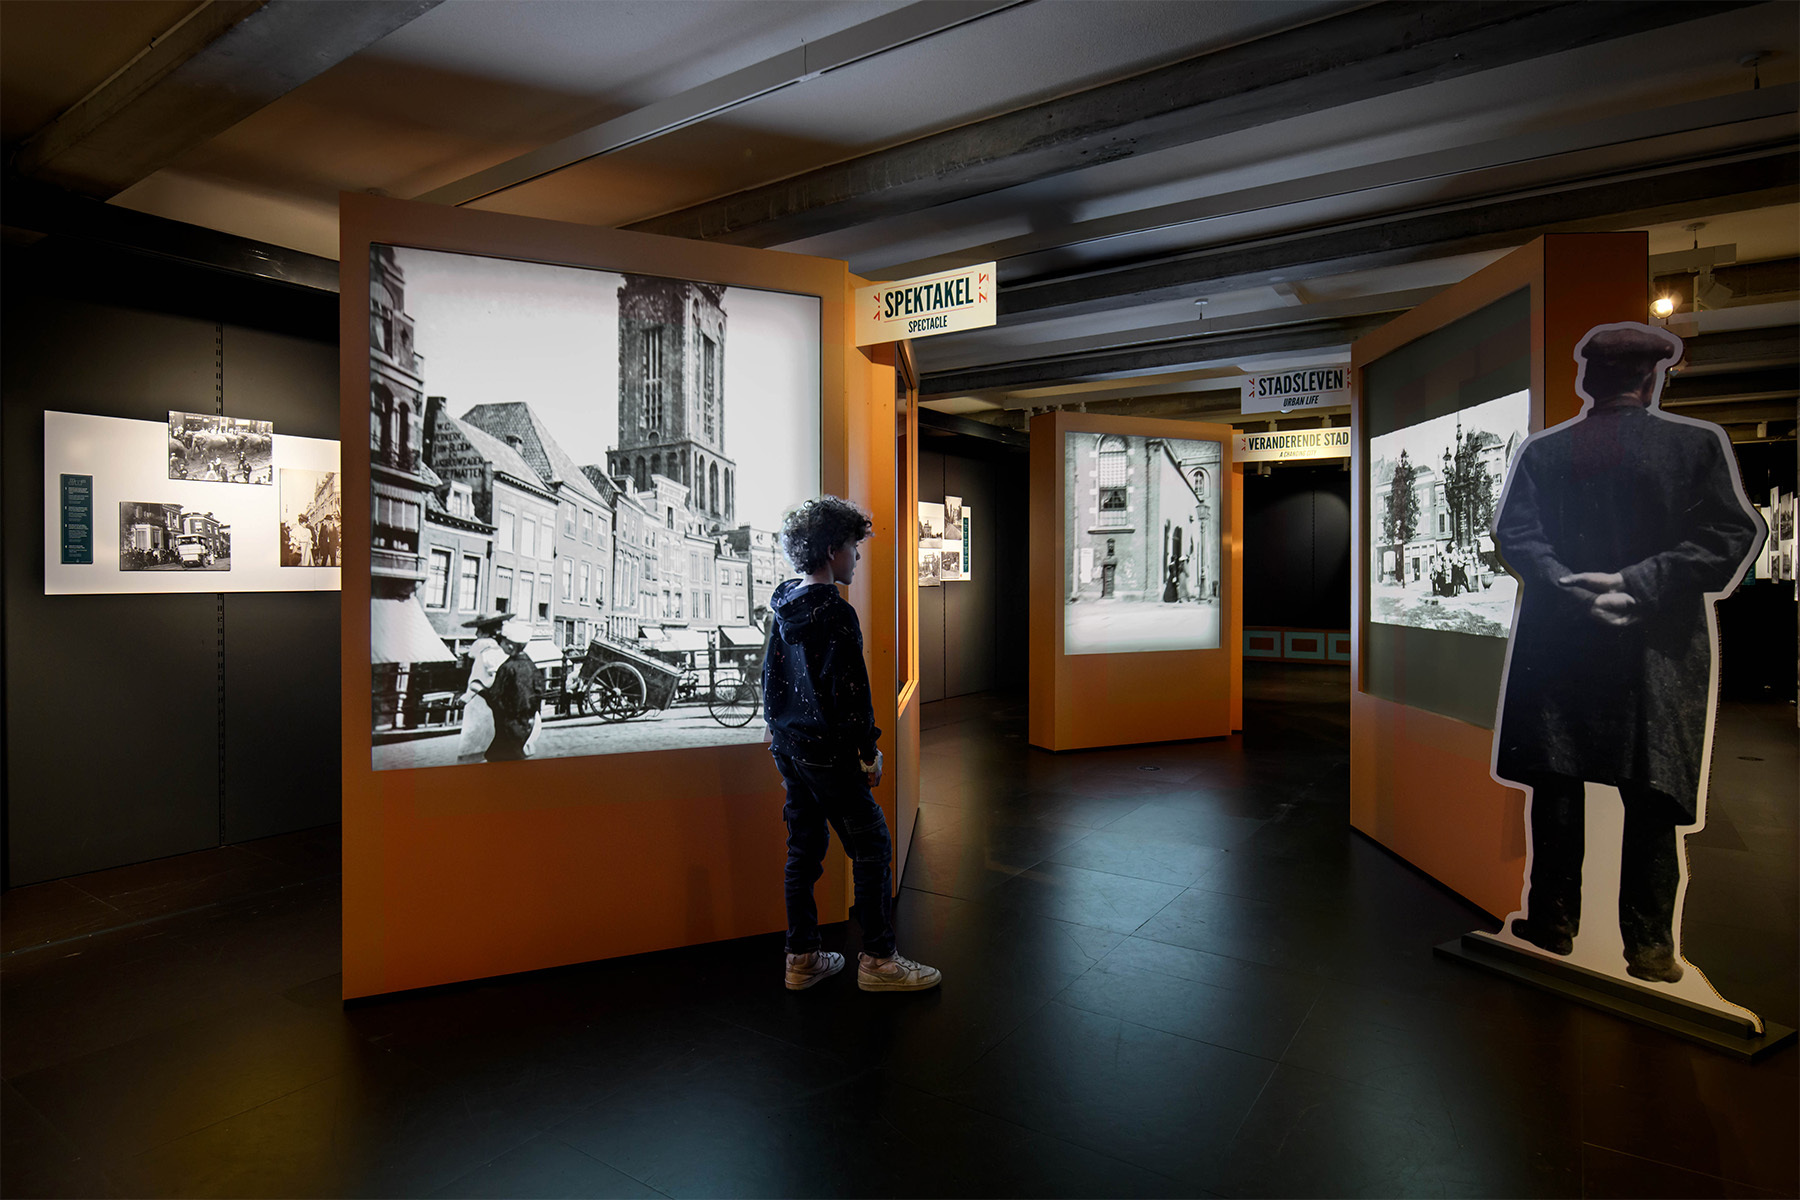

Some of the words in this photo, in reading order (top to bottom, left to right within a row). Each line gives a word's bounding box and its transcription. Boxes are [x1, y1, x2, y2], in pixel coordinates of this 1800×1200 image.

[884, 277, 974, 318] SPEKTAKEL
[908, 315, 948, 333] SPECTACLE
[1258, 369, 1344, 396] STADSLEVEN
[1283, 396, 1305, 407] URBAN
[1305, 395, 1320, 405] LIFE
[1248, 433, 1322, 451] VERANDERENDE
[1323, 432, 1349, 446] STAD
